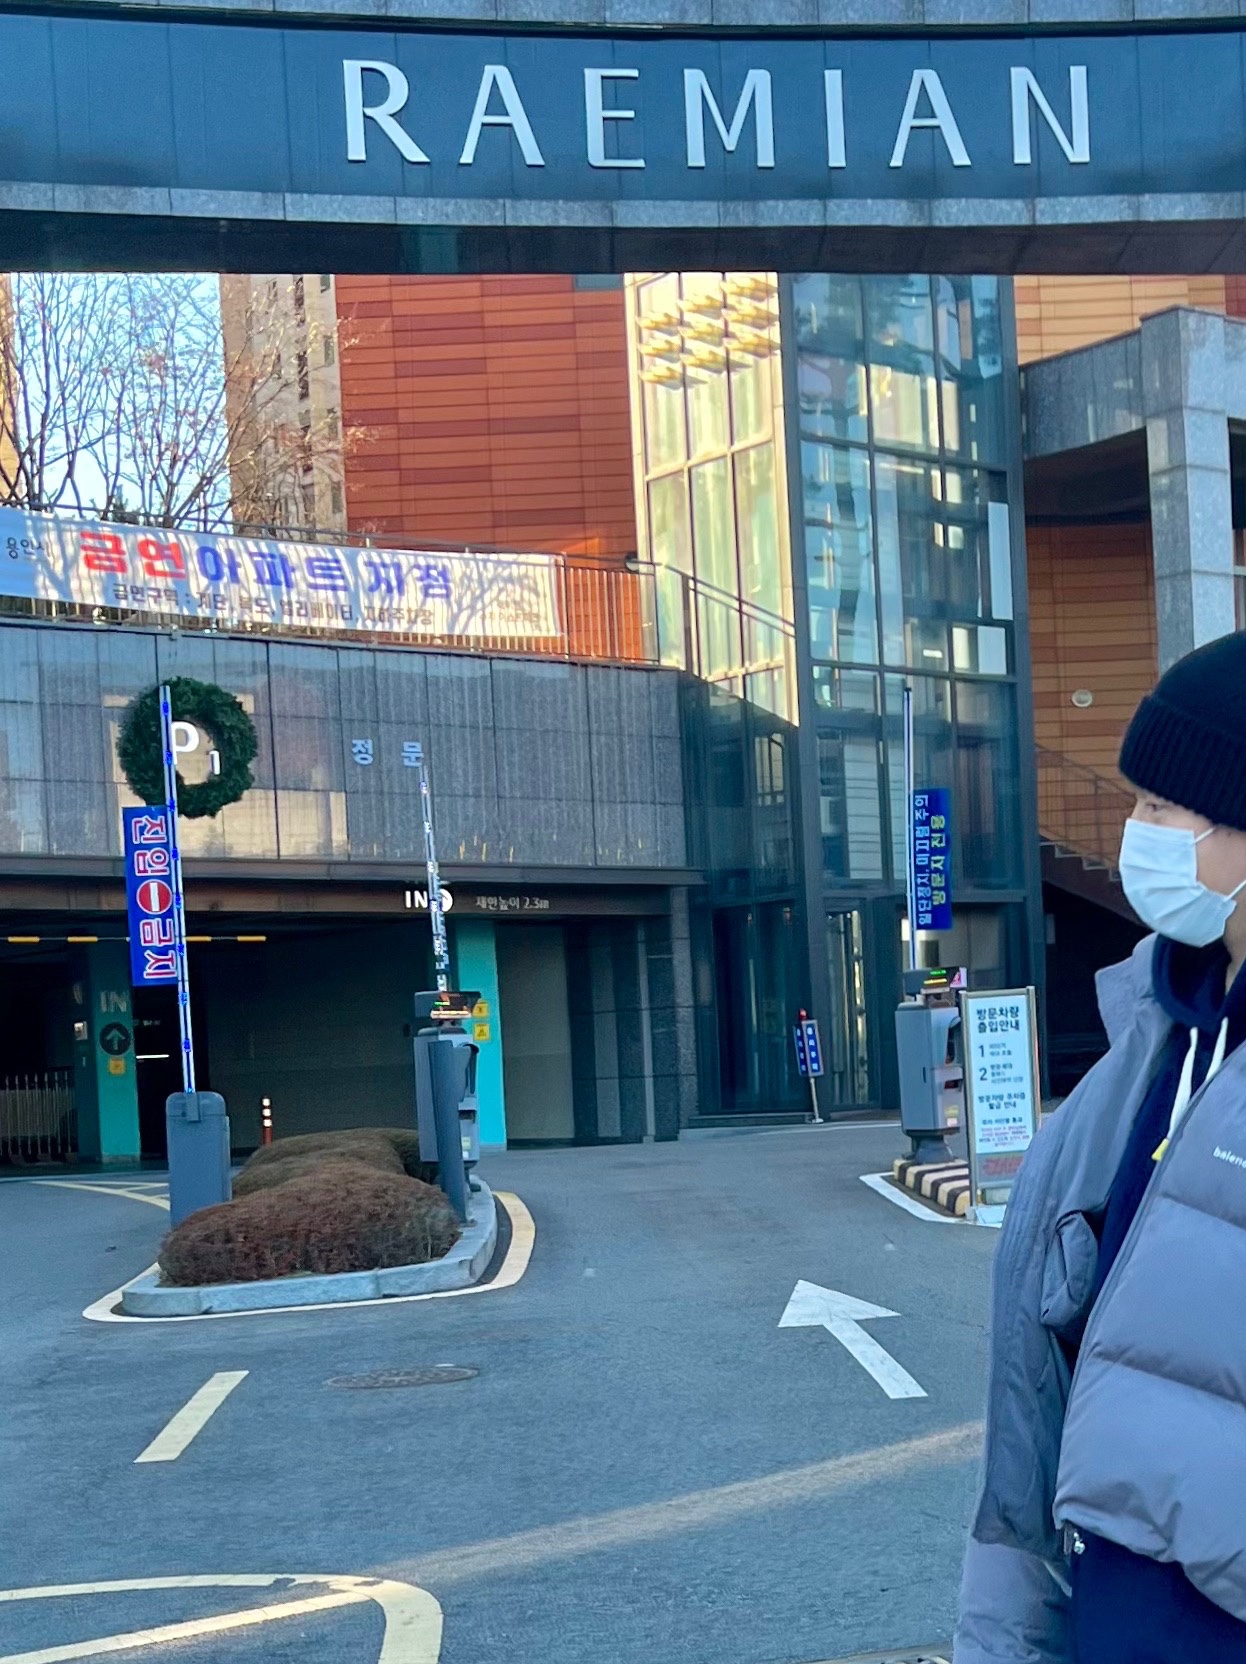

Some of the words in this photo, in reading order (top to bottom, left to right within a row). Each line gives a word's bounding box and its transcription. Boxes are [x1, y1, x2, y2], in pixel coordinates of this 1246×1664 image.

[342, 59, 1090, 168] RAEMIAN
[404, 890, 428, 909] IN
[100, 991, 127, 1013] IN
[976, 1005, 1020, 1021] 방문차량
[977, 1019, 1021, 1034] 출입안내
[978, 1044, 985, 1058] 1
[979, 1066, 988, 1081] 2
